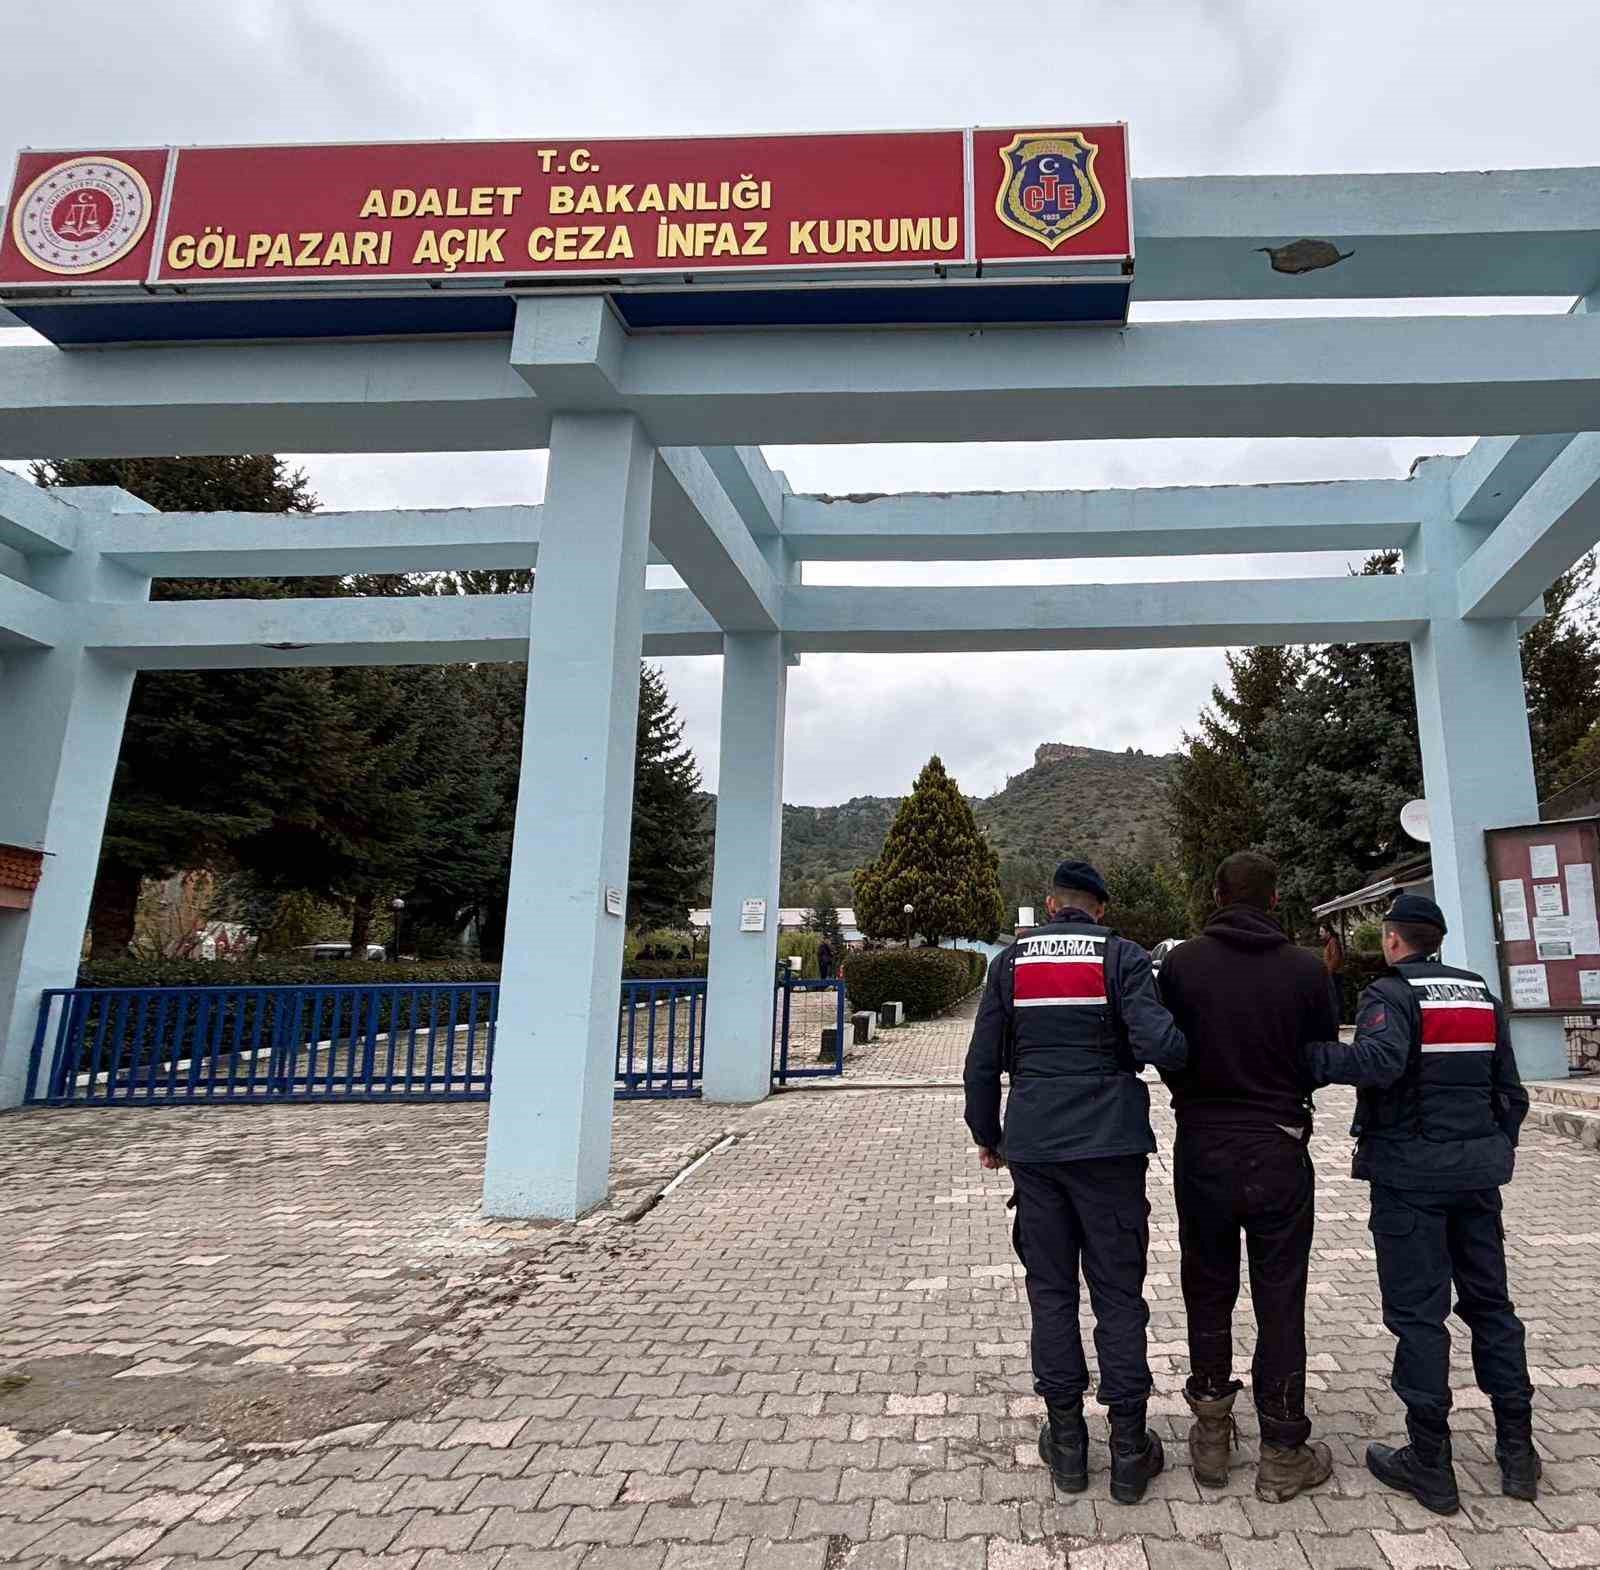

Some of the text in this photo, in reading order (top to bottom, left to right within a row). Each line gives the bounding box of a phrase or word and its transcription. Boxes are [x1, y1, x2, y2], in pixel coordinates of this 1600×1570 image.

[537, 149, 600, 173] T.C.
[359, 173, 771, 218] ADALET BAKANLIĞI
[1023, 175, 1076, 212] CTE
[167, 216, 958, 272] GÖLPAZARI AÇIK CEZA İNFAZ KURUMU
[1022, 939, 1096, 957] JANDARMA
